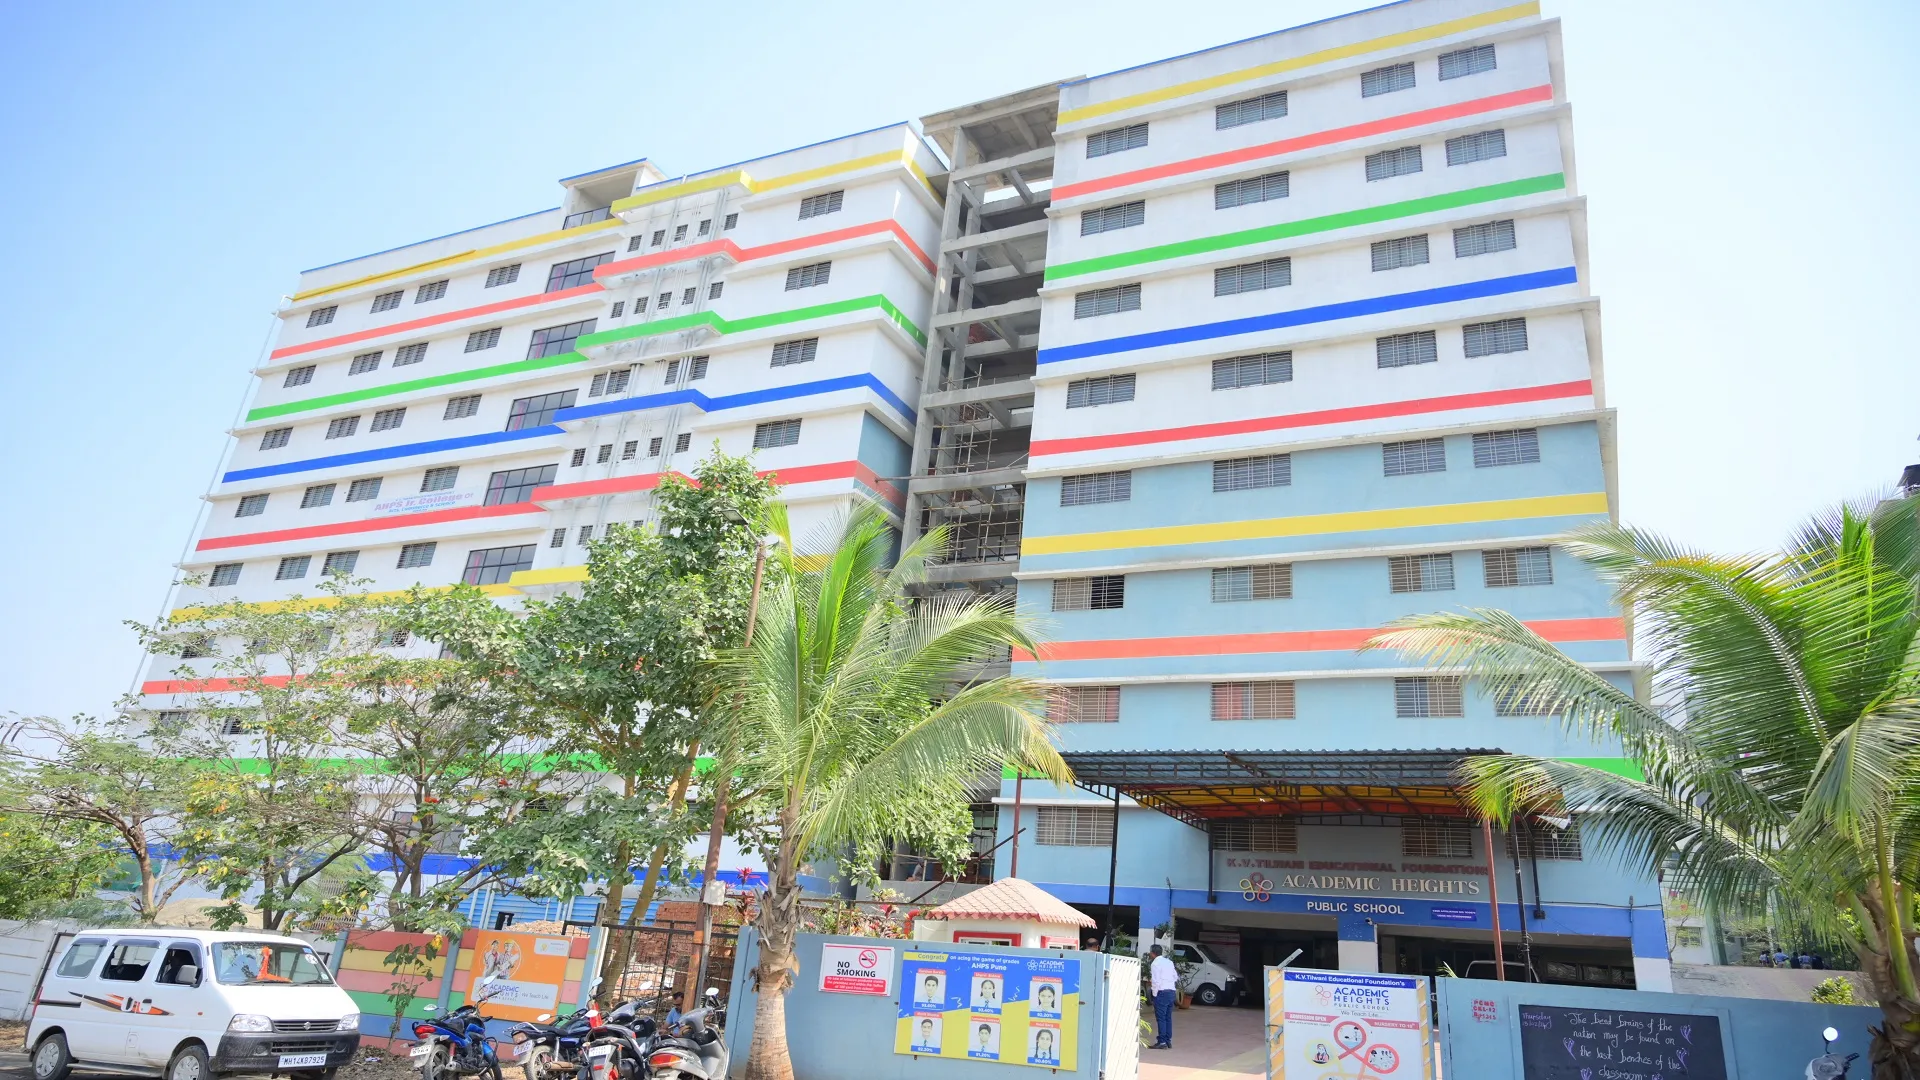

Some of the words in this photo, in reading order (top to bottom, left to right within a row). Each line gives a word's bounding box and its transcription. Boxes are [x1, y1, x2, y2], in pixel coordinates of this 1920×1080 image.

[374, 500, 404, 511] AHPS
[419, 493, 463, 505] College
[1281, 874, 1380, 891] ACADEMIC
[1391, 878, 1480, 895] HEIGHTS
[1307, 902, 1348, 912] PUBLIC
[1354, 903, 1405, 914] SCHOOL
[836, 968, 876, 978] SMOKING
[489, 984, 520, 992] ACADEMIC
[1334, 987, 1389, 998] ACADEMIC
[1334, 995, 1390, 1006] HEIGHTS
[1616, 1014, 1644, 1029] brains
[1647, 1019, 1654, 1034] of
[1658, 1018, 1673, 1031] the
[1573, 1026, 1596, 1039] nation
[1603, 1032, 1619, 1048] may
[1624, 1029, 1634, 1042] be
[1638, 1031, 1660, 1044] found
[1580, 1045, 1592, 1057] the
[1596, 1045, 1612, 1060] last
[1618, 1049, 1652, 1065] benches
[1655, 1055, 1663, 1070] of
[1668, 1057, 1681, 1070] the
